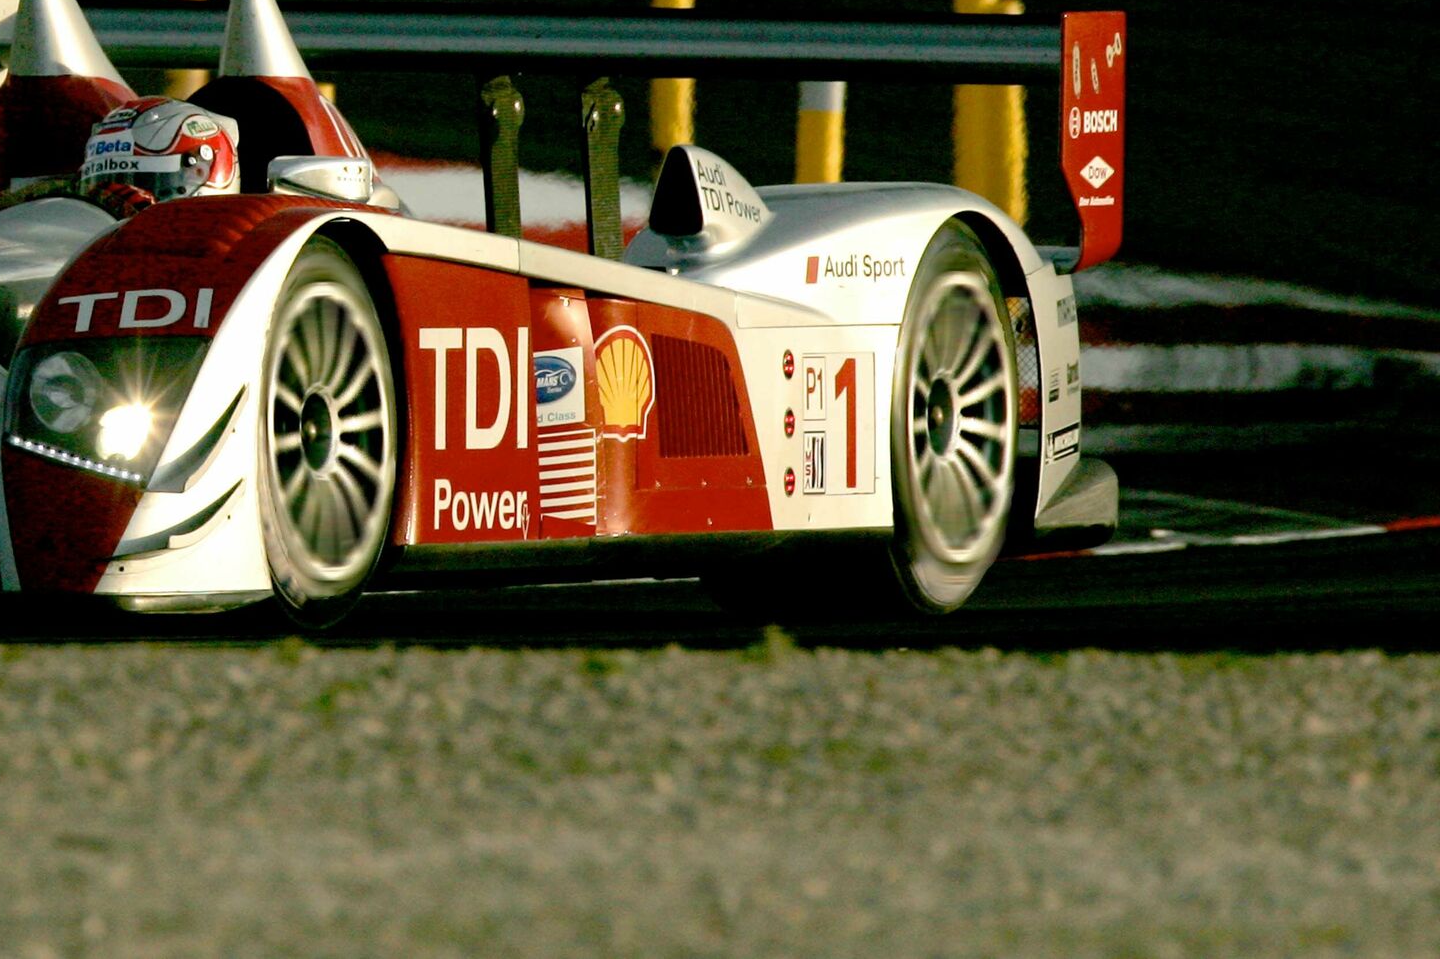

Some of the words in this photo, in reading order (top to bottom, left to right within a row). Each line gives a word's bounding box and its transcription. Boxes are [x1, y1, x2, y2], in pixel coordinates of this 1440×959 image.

[1083, 109, 1118, 134] BOSCH
[96, 139, 131, 154] Beta
[84, 158, 139, 176] etalbox
[697, 160, 726, 186] Audi
[701, 187, 725, 212] TDI
[728, 192, 761, 223] Power
[824, 255, 858, 278] Audi
[863, 255, 905, 282] Sport
[58, 288, 214, 333] TDI
[419, 327, 528, 450] TDI
[806, 367, 823, 410] P1
[547, 411, 576, 422] Class
[835, 358, 856, 488] 1
[434, 478, 528, 530] Power
